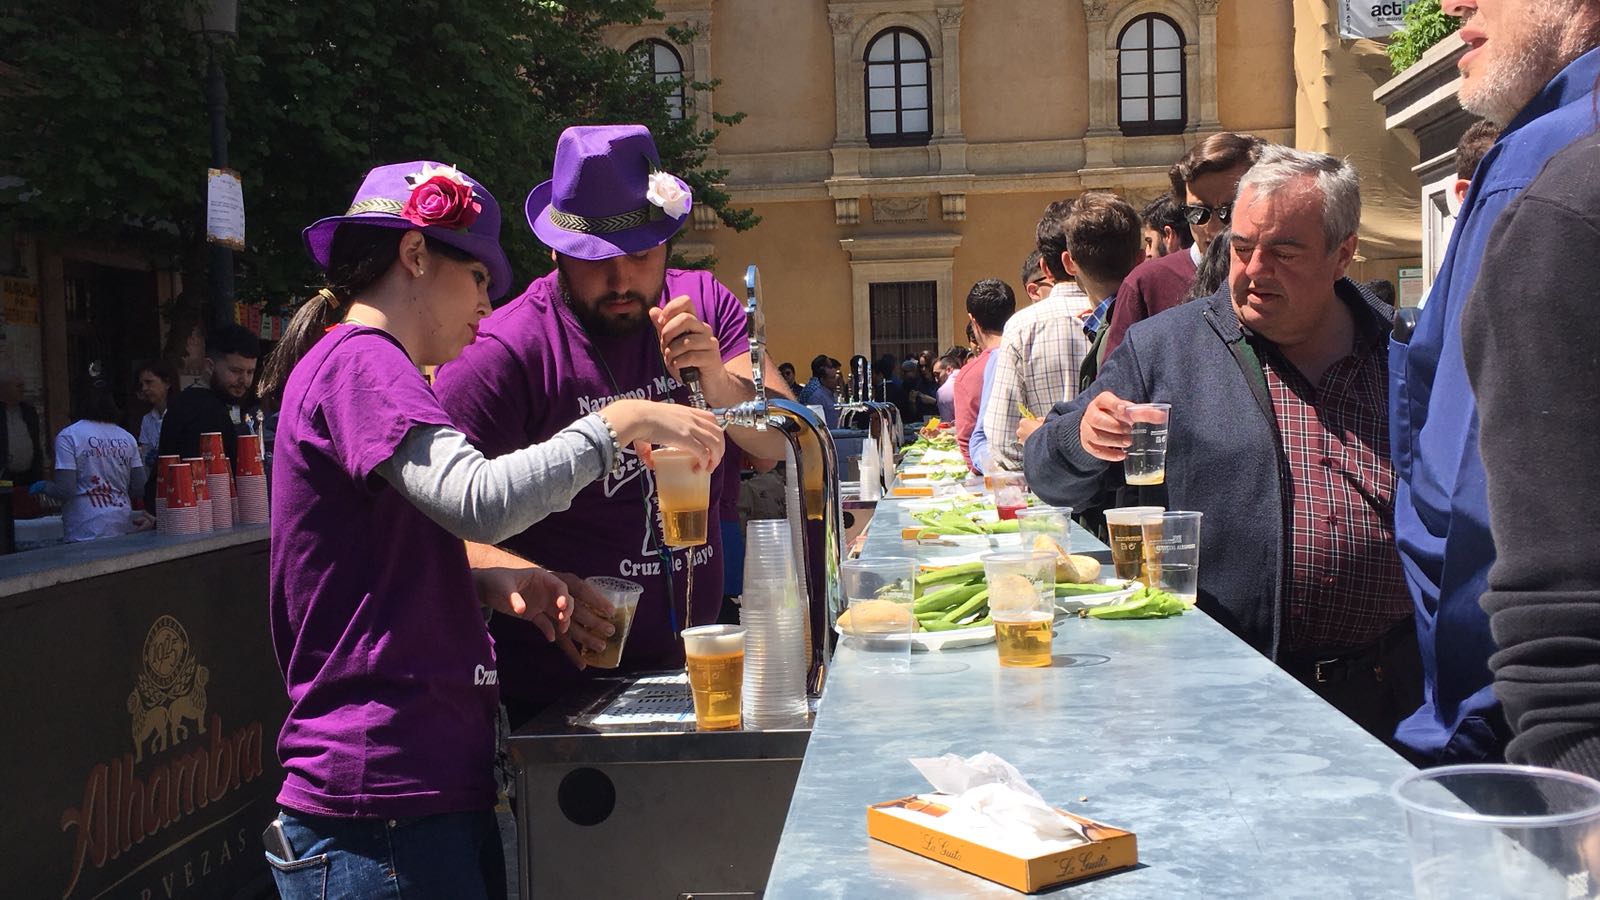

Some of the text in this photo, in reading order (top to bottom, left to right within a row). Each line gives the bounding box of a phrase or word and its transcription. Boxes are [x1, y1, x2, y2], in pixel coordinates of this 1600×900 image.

[1370, 1, 1410, 17] acti
[620, 559, 660, 577] Cruz
[474, 664, 500, 686] Cru
[61, 712, 264, 900] Alhambra
